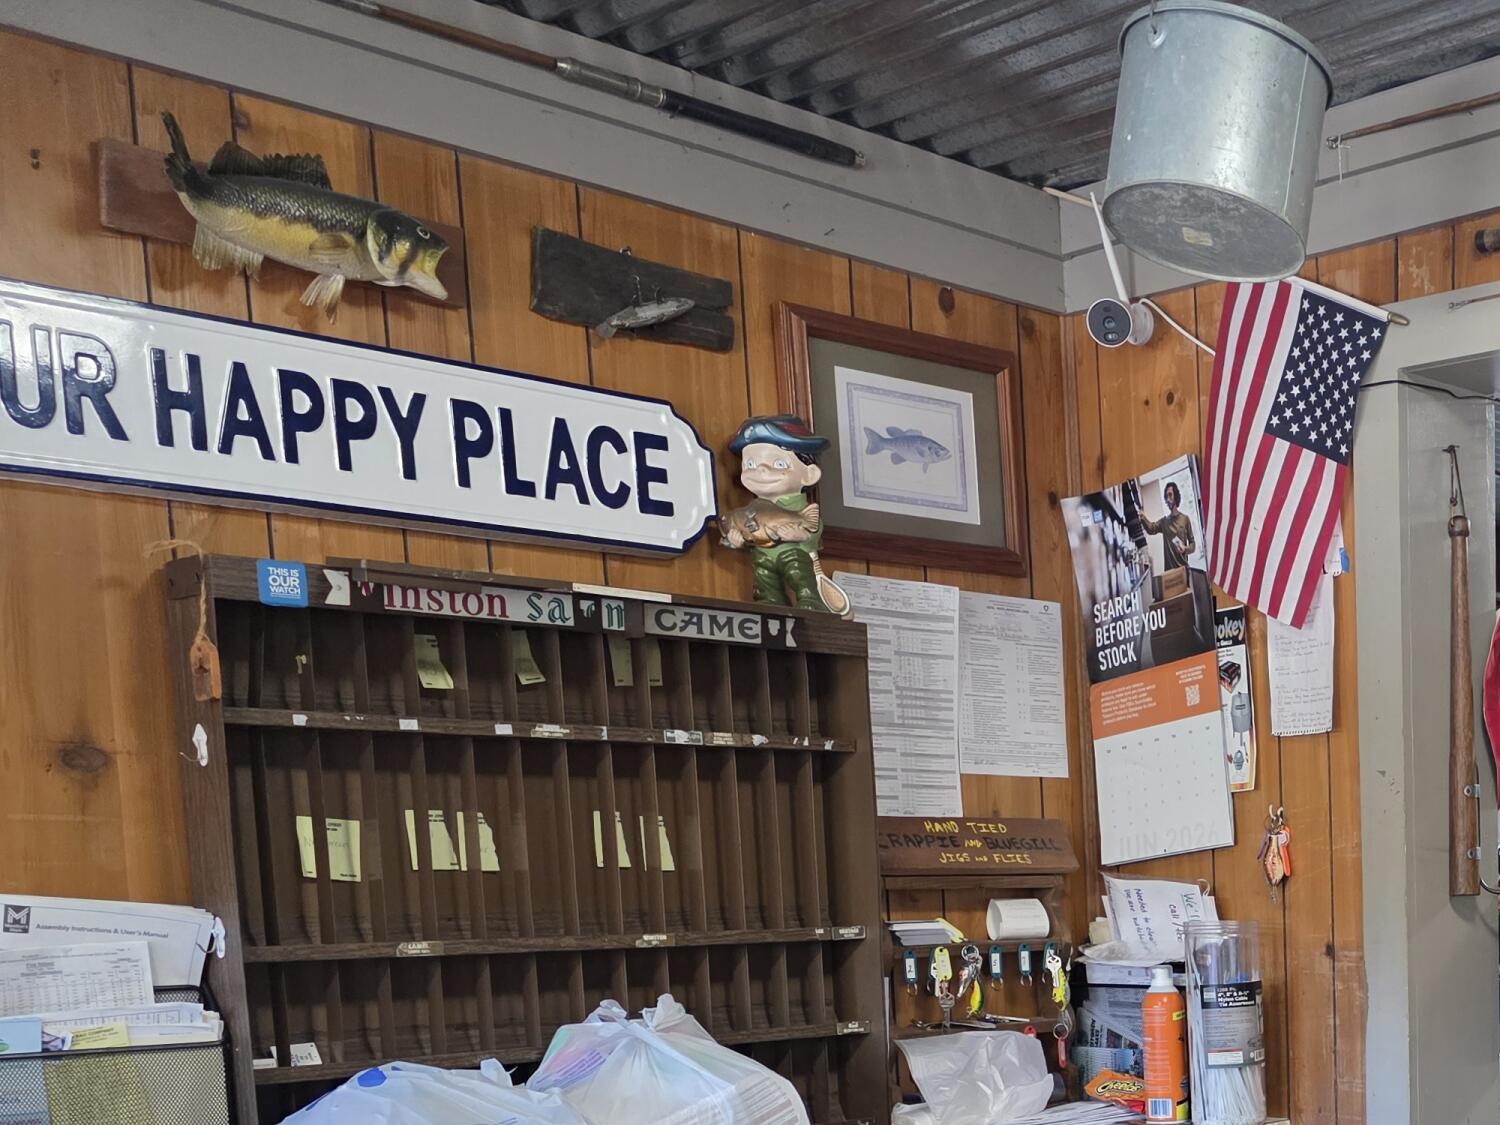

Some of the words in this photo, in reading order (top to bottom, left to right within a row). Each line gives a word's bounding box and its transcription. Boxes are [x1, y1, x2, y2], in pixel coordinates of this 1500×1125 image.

[149, 345, 427, 481] HAPPY
[450, 397, 675, 518] PLACE
[267, 567, 288, 576] THIS
[289, 569, 299, 577] IS
[268, 575, 300, 587] OUR
[269, 584, 301, 595] WATCH
[526, 592, 625, 629] Sam
[1094, 591, 1140, 623] SEARCH
[654, 608, 761, 640] CAME
[1095, 617, 1140, 648] BEFORE
[1142, 607, 1167, 636] YOU
[1097, 642, 1137, 671] STOCK
[924, 820, 960, 833] HAND
[966, 821, 1008, 834] TIED
[983, 836, 1063, 851] BLUEGILL
[938, 852, 971, 864] JIGS
[992, 852, 1034, 865] FLIES
[35, 923, 70, 932] Assembly
[71, 925, 112, 934] Instructions
[120, 929, 143, 937] User's
[143, 931, 169, 939] Manual
